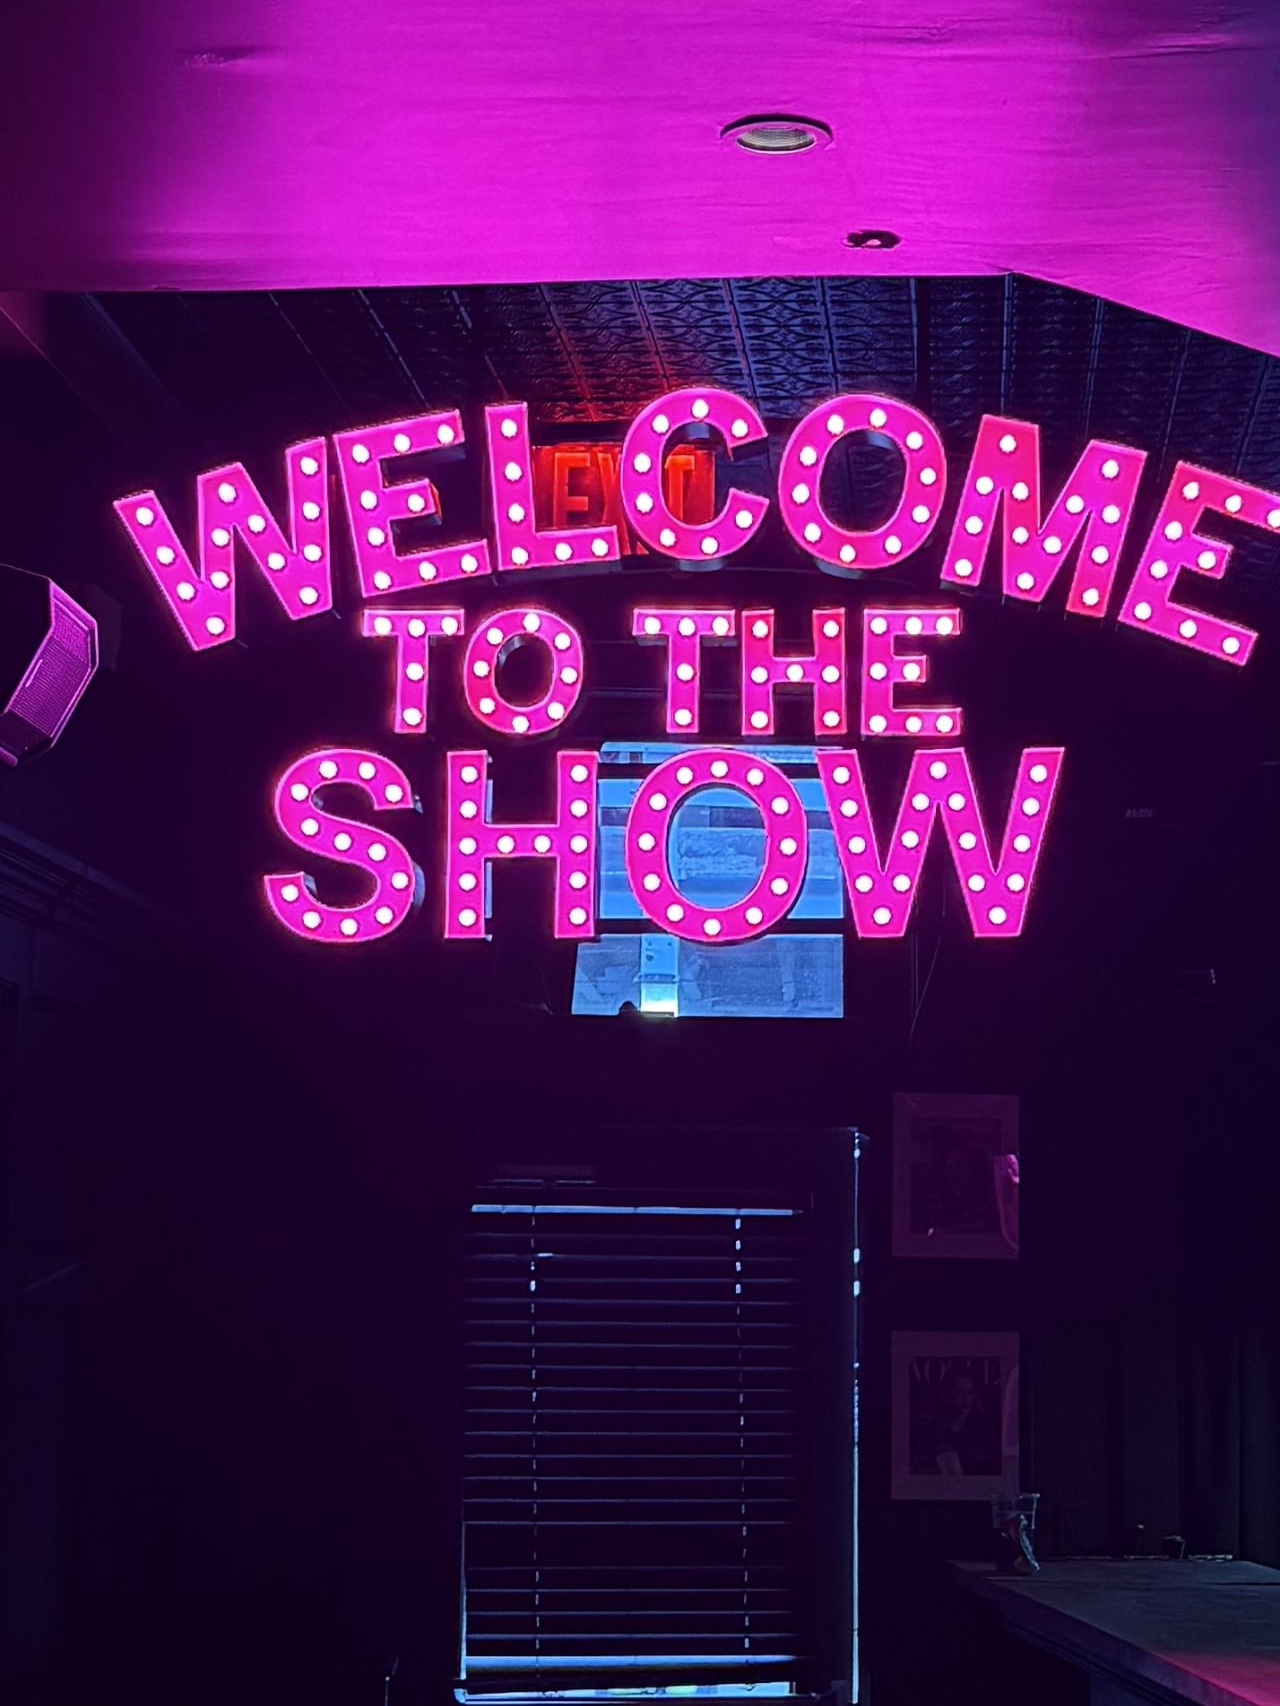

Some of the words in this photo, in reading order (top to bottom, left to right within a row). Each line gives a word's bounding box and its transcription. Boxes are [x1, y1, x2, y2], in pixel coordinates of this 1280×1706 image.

[551, 450, 697, 555] EXT
[361, 606, 585, 735] TO
[632, 606, 962, 736] THE
[263, 746, 1065, 943] SHOW
